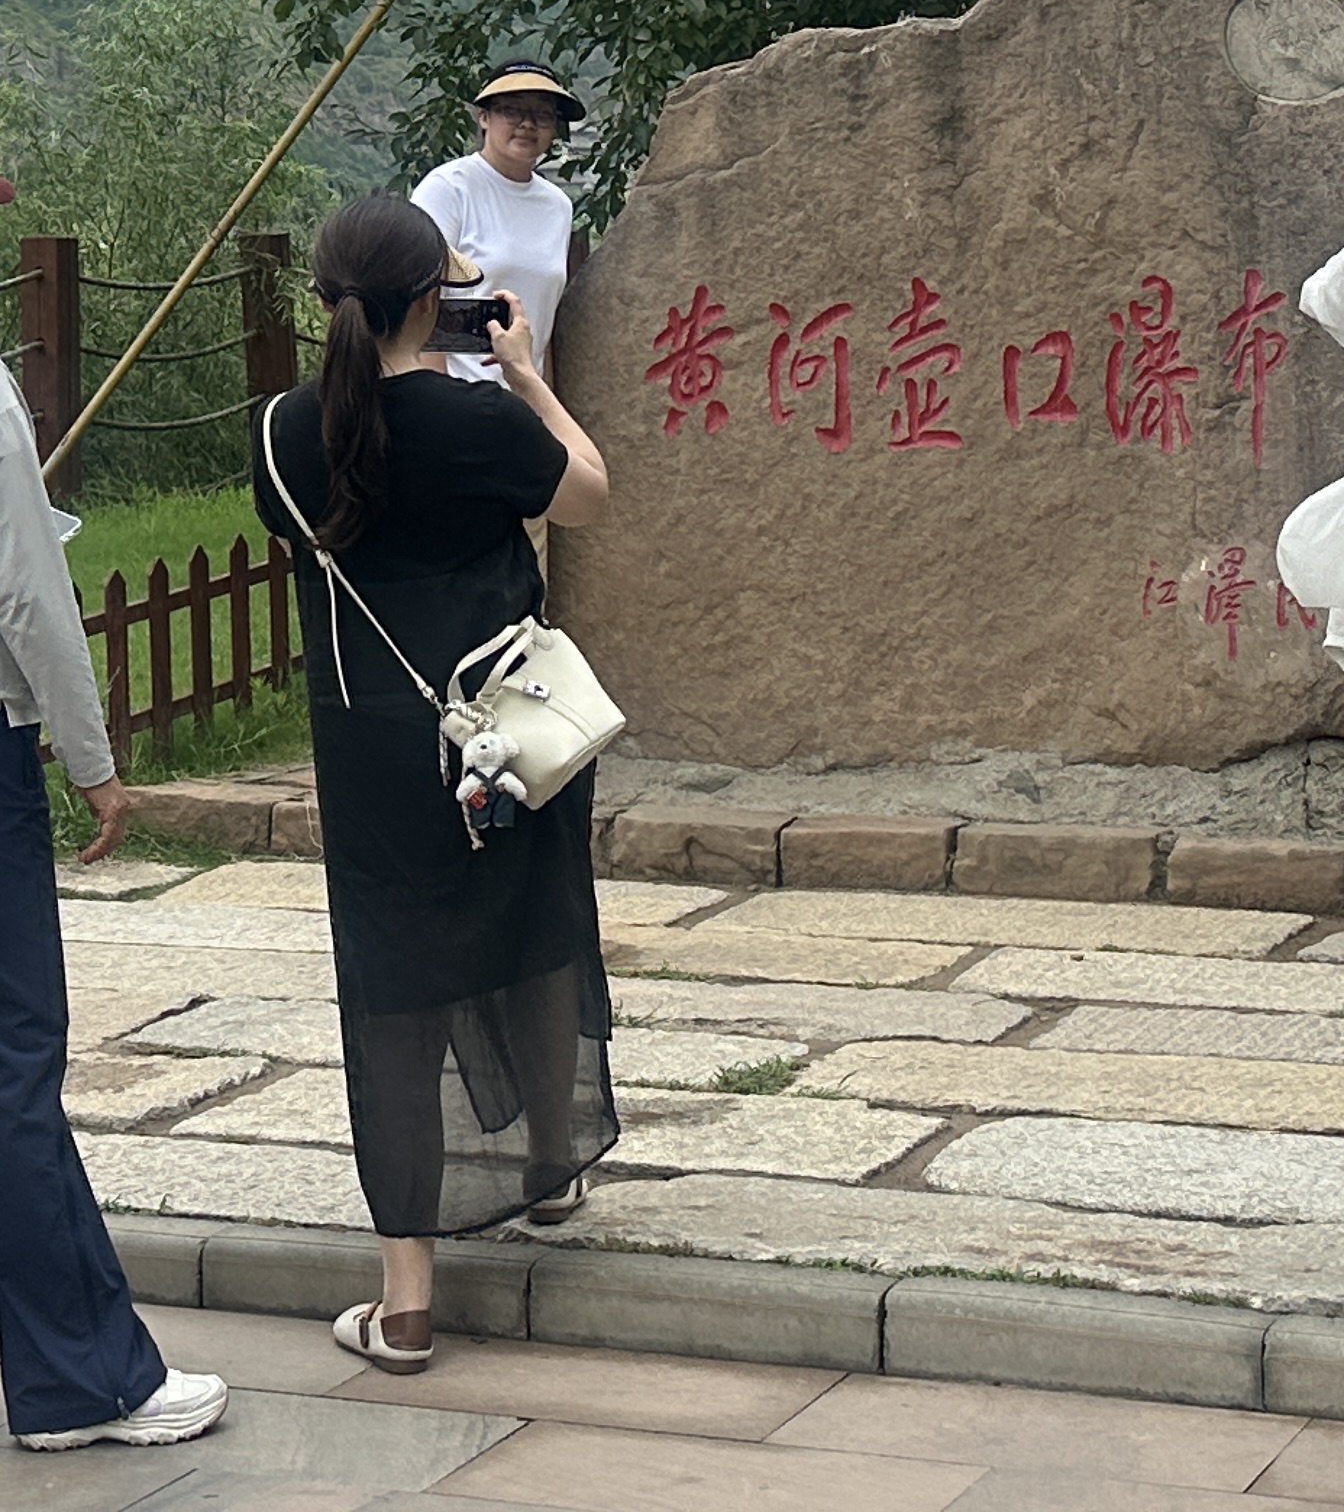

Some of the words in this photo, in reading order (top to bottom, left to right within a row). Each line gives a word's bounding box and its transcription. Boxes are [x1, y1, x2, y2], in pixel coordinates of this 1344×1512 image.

[645, 268, 1287, 466] 黄河壶口瀑布
